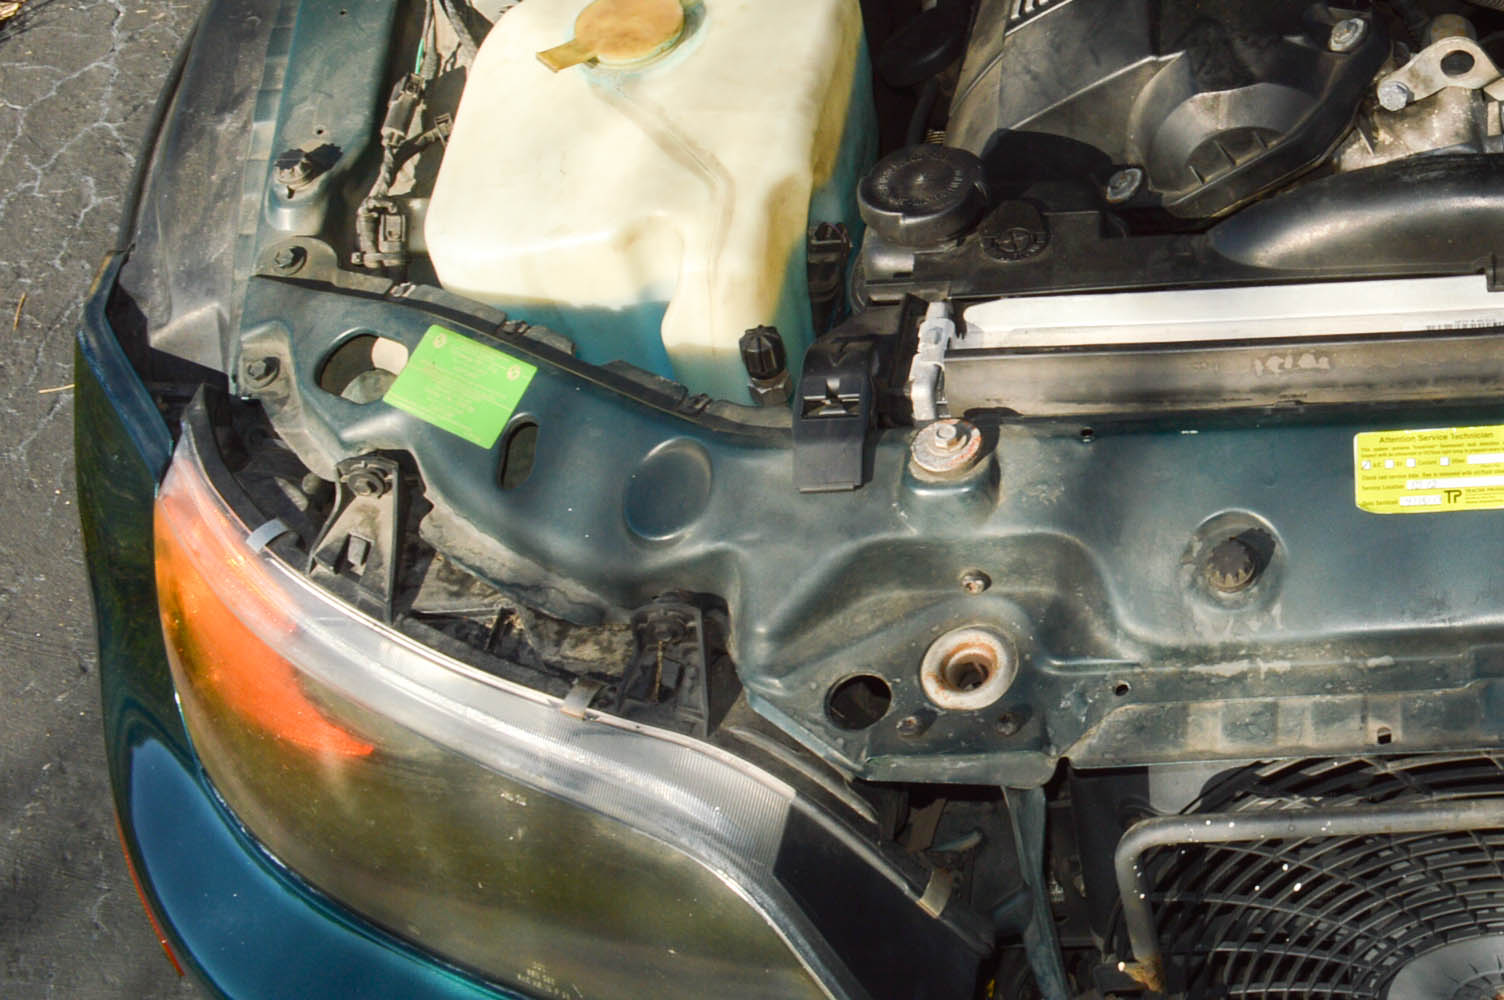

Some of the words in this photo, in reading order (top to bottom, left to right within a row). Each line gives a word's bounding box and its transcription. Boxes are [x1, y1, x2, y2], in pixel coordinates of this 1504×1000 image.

[1379, 436, 1416, 444] Attention
[1418, 434, 1448, 442] Service
[1450, 431, 1494, 440] Technician
[1443, 489, 1462, 504] TP
